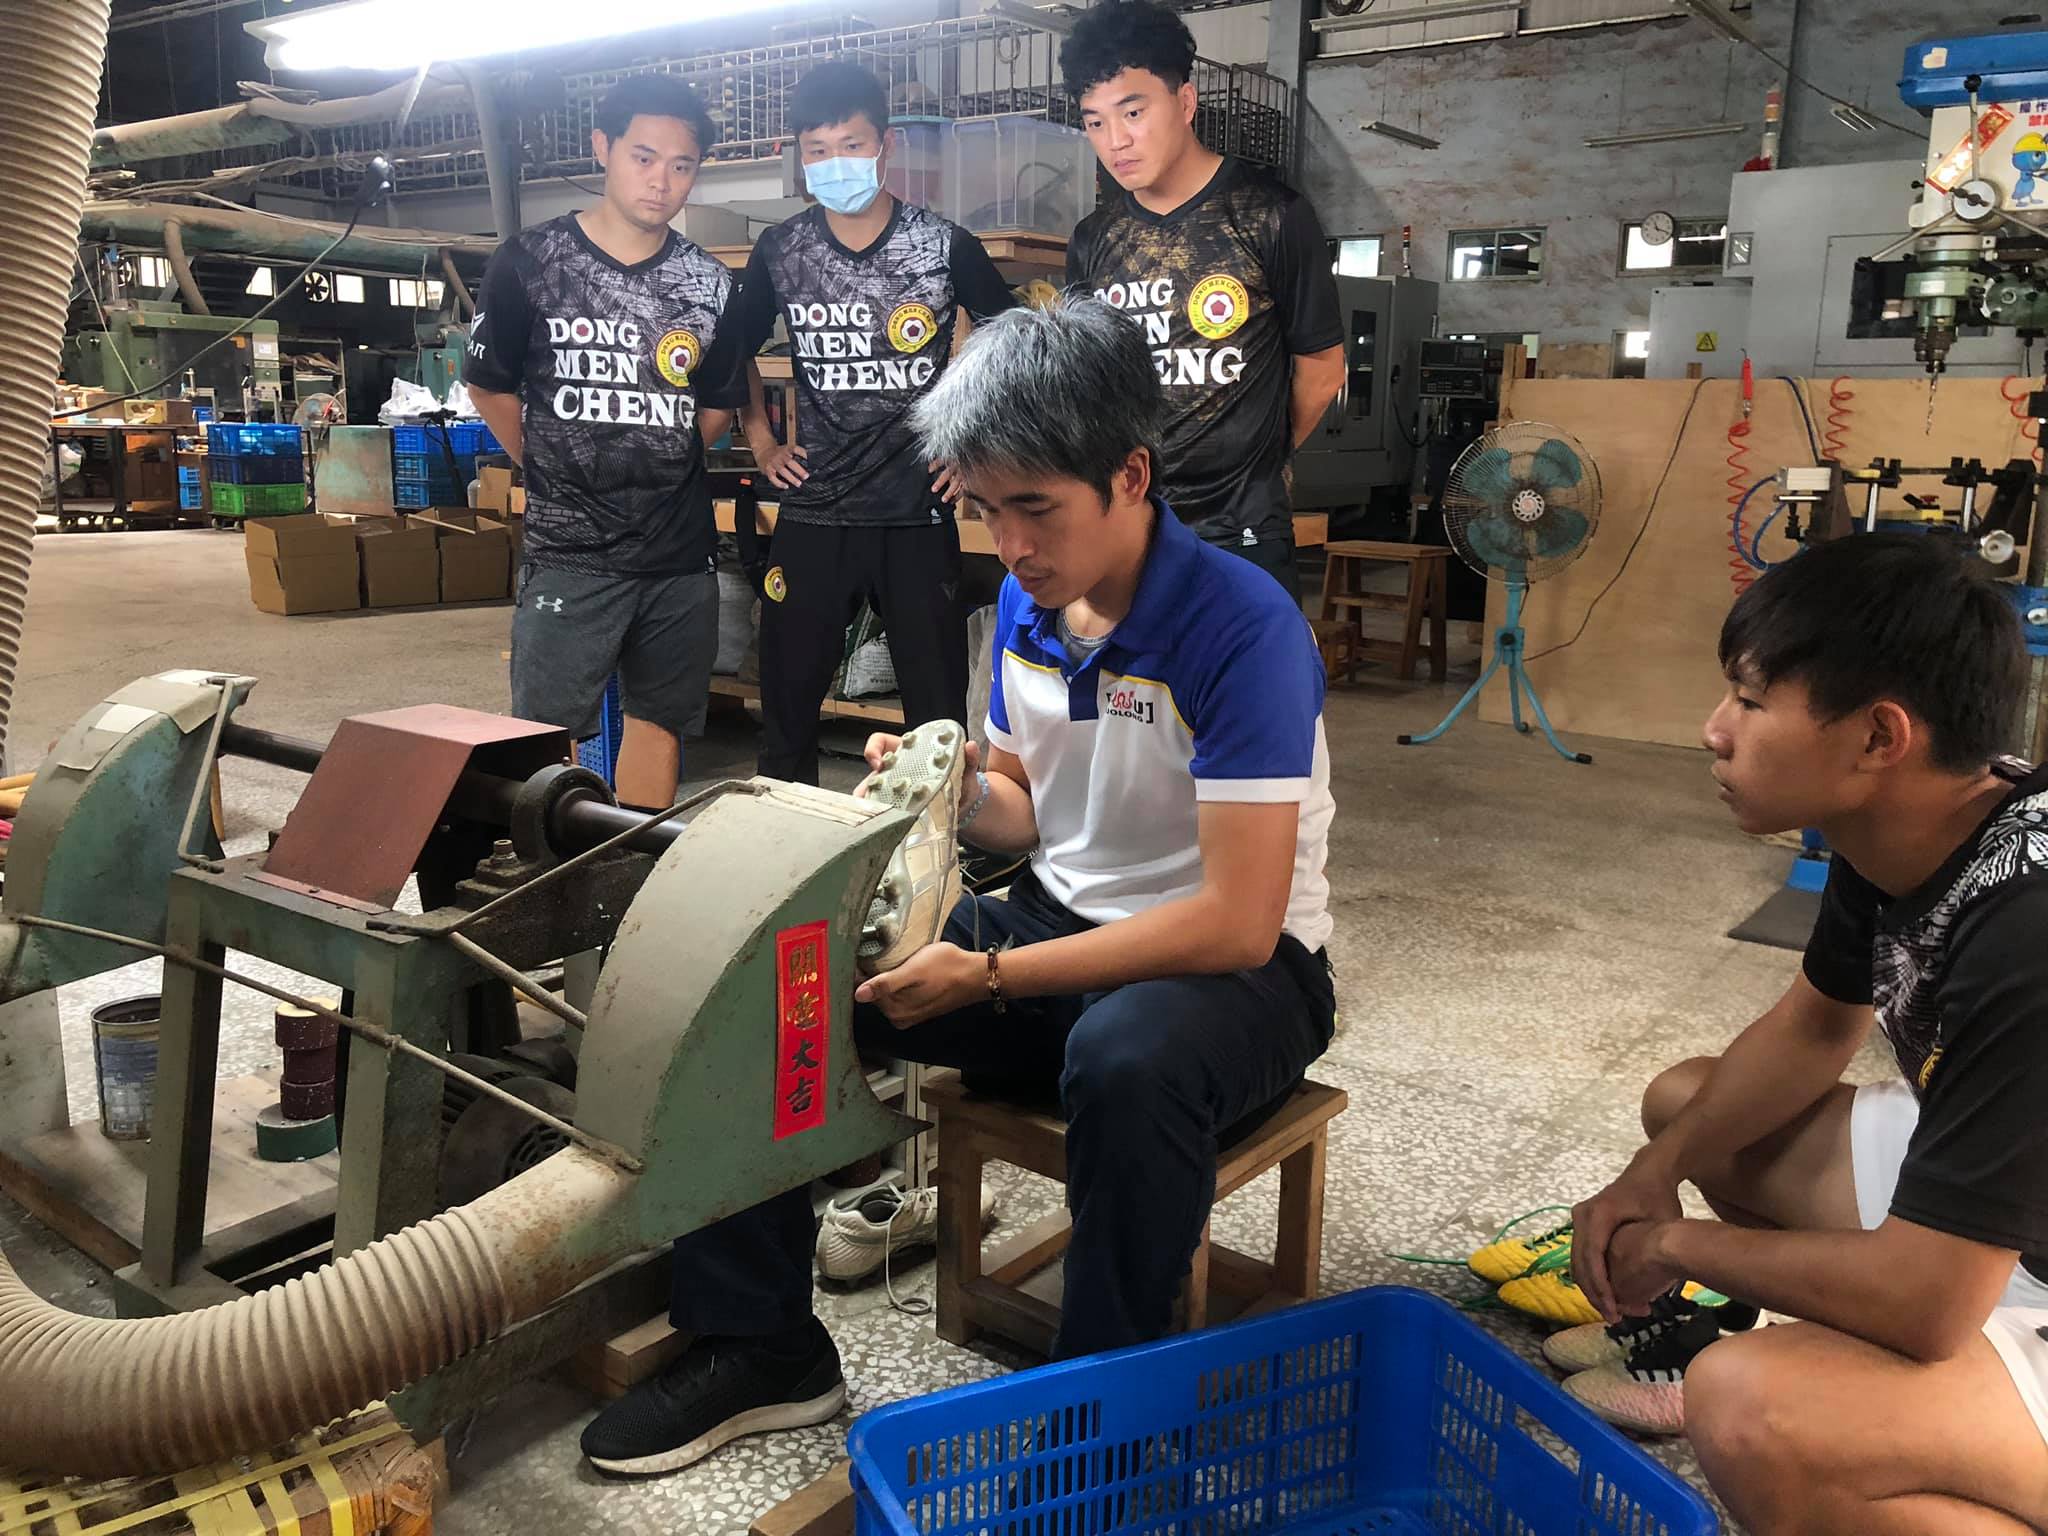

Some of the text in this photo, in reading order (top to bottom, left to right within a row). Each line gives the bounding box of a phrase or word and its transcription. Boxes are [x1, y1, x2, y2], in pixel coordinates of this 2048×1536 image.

[787, 303, 873, 327] DONG
[545, 317, 642, 348] DONG
[794, 332, 874, 358] MEN
[552, 349, 641, 384] MEN
[802, 357, 936, 391] CHENG
[1151, 347, 1248, 385] ENG
[553, 385, 696, 429] CHENG
